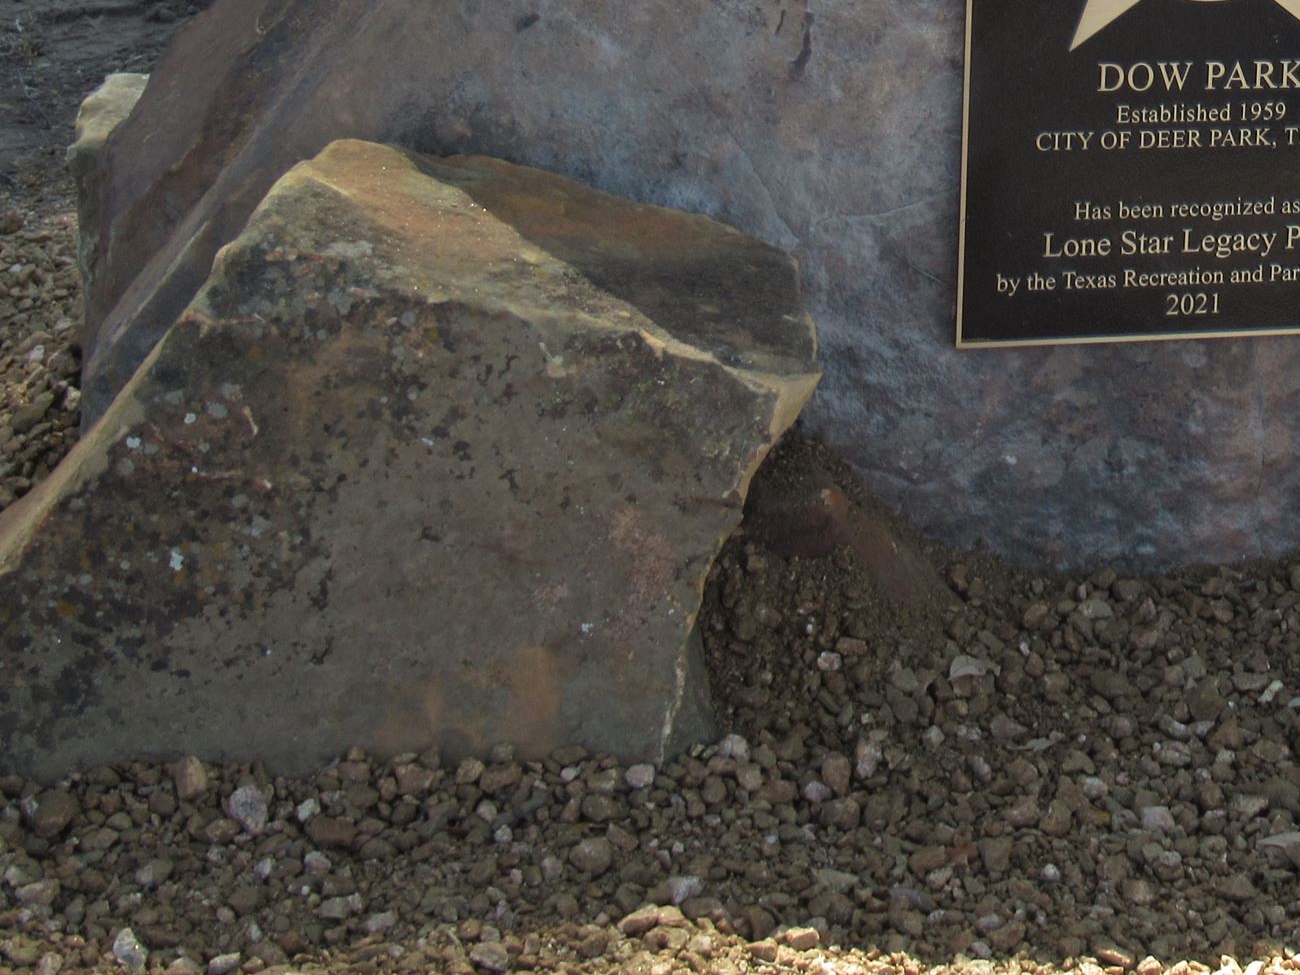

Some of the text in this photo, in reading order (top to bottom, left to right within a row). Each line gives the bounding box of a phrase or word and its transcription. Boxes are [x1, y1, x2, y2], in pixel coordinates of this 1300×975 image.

[1098, 61, 1194, 92] DOW
[1116, 102, 1287, 123] Established 1959
[1036, 132, 1094, 151] CITY
[1100, 131, 1132, 150] OF
[1138, 129, 1202, 149] DEER
[1209, 128, 1277, 150] PARK,
[1074, 201, 1112, 221] Has
[1118, 199, 1164, 219] been
[1170, 197, 1275, 221] recognized
[1281, 201, 1300, 215] as
[1043, 231, 1112, 259] Lone
[1120, 229, 1174, 256] Star
[1182, 227, 1277, 258] Legacy
[996, 273, 1020, 297] by
[1026, 272, 1056, 291] the
[1062, 271, 1117, 290] Texas
[1123, 267, 1224, 288] Recreation
[1230, 266, 1264, 285] and
[1165, 293, 1221, 317] 2021
